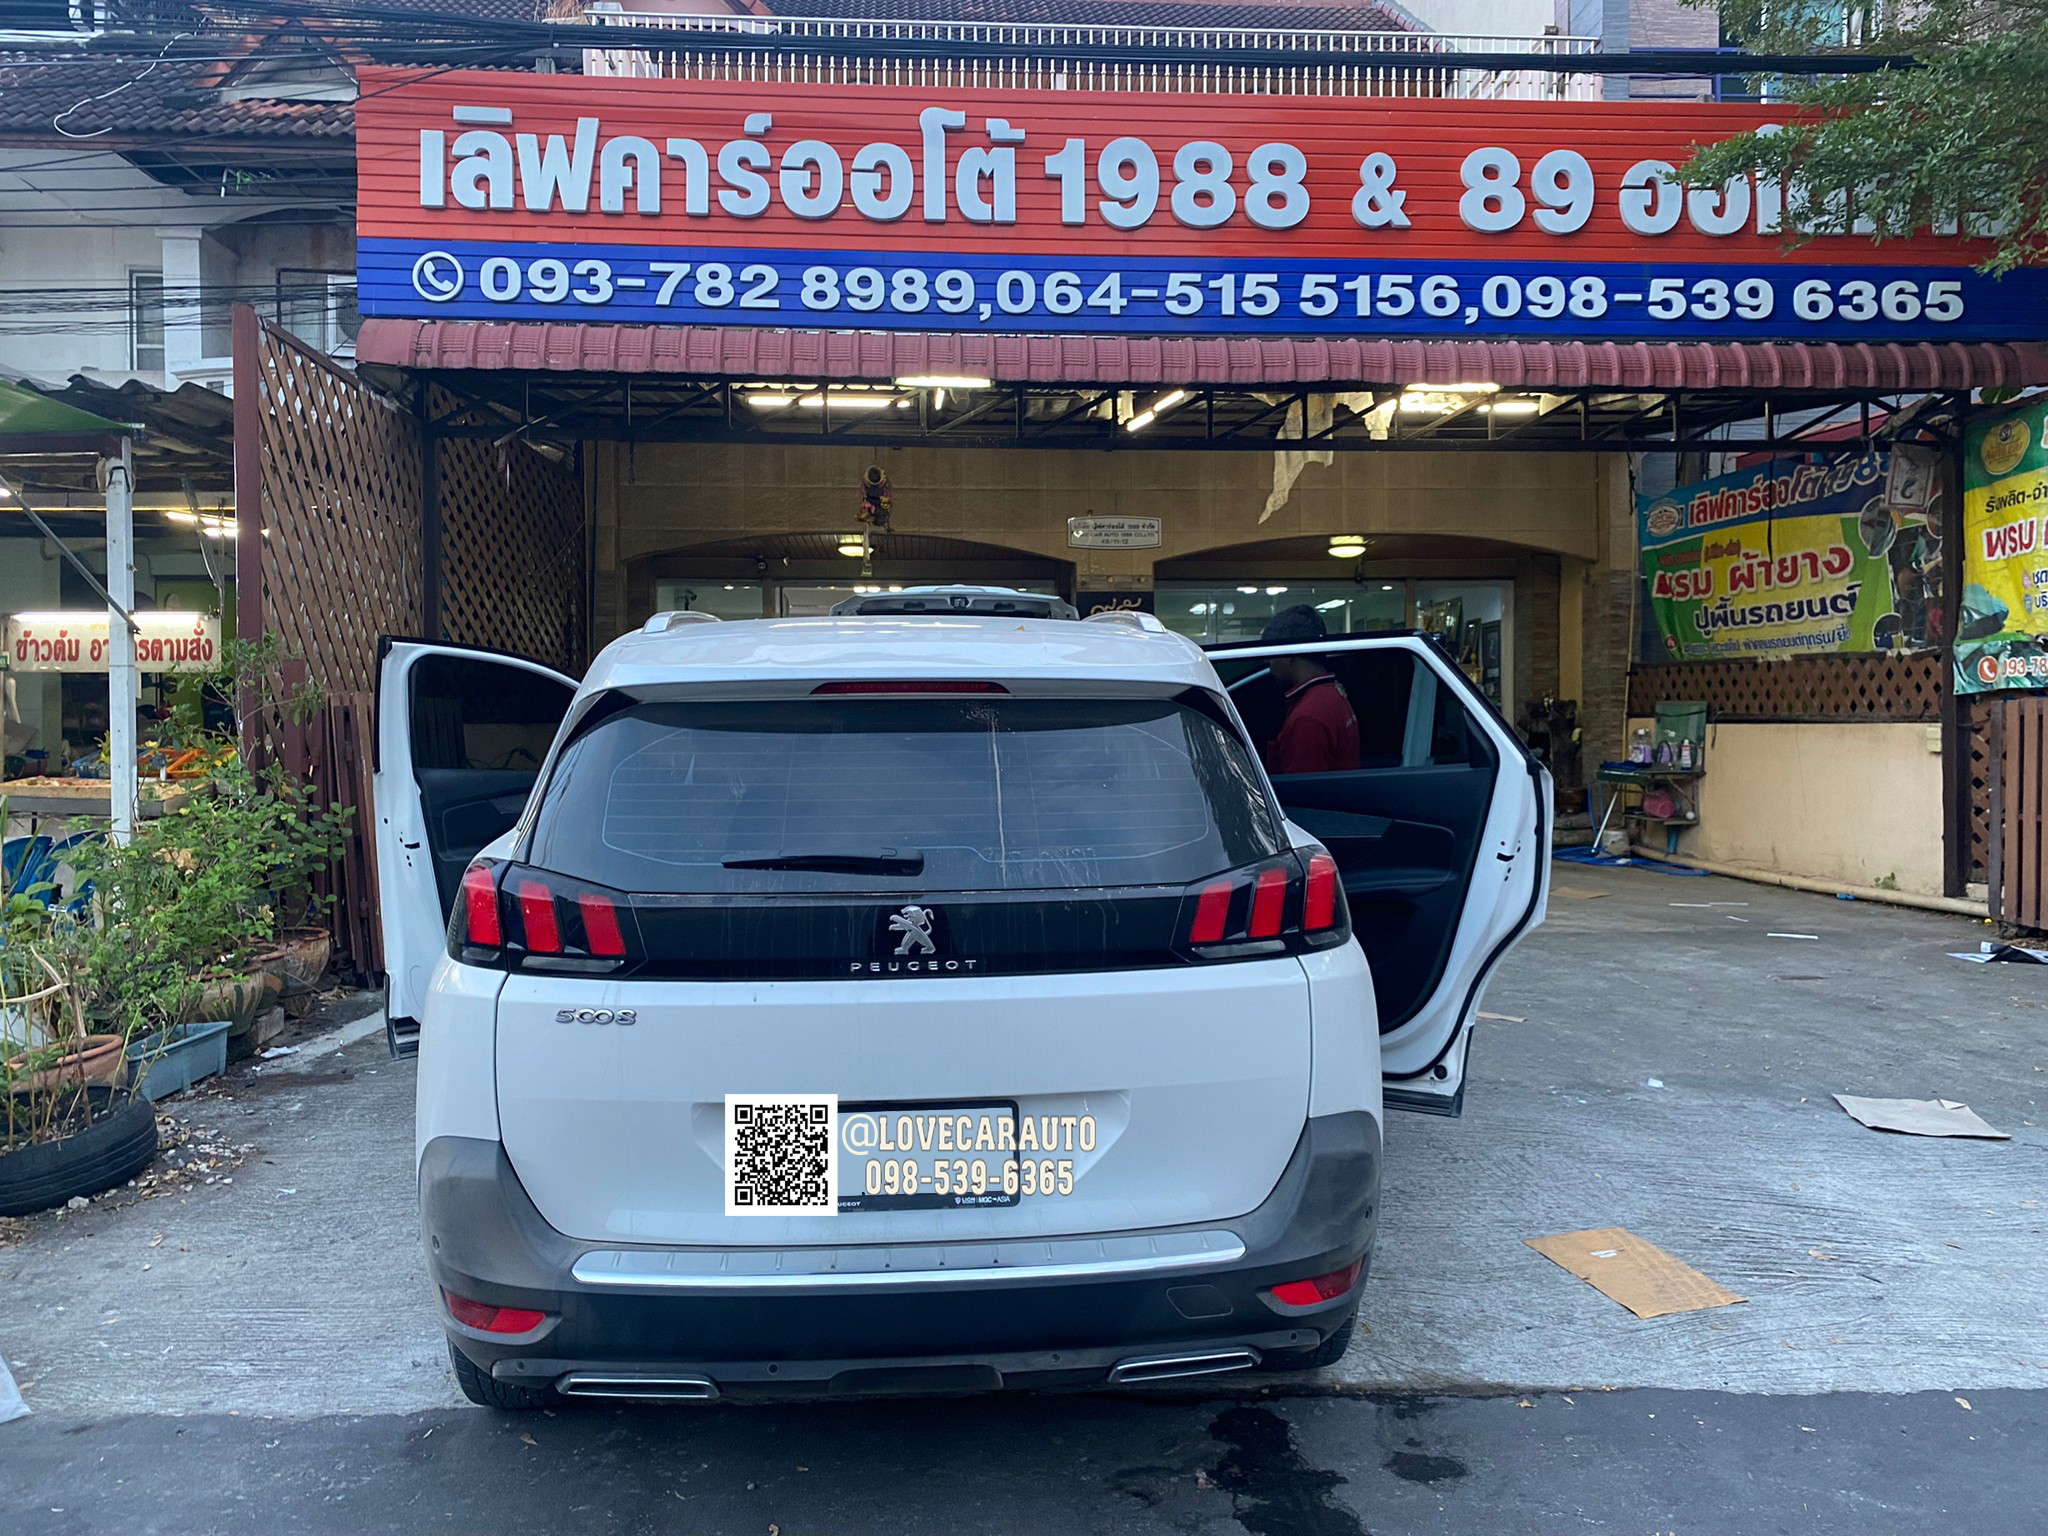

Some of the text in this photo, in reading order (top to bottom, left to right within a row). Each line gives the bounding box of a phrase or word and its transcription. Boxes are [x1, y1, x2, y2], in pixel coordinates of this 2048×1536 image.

[419, 105, 1027, 224] เลิฟคาร์ออโต้
[1043, 136, 1311, 231] 1988
[1351, 150, 1411, 230] &
[1458, 146, 1596, 235] 89
[479, 255, 1965, 325] 093-782 8989,064-515 5156,098-539 6365
[1687, 463, 1827, 527] เลิฟคาร์ออโต้
[1982, 516, 2038, 562] พรม
[1729, 545, 1854, 596] ผ้ายาง
[16, 630, 81, 662] ข้าวต้ม
[850, 959, 977, 973] PEUGEOT
[555, 1008, 637, 1026] 5008
